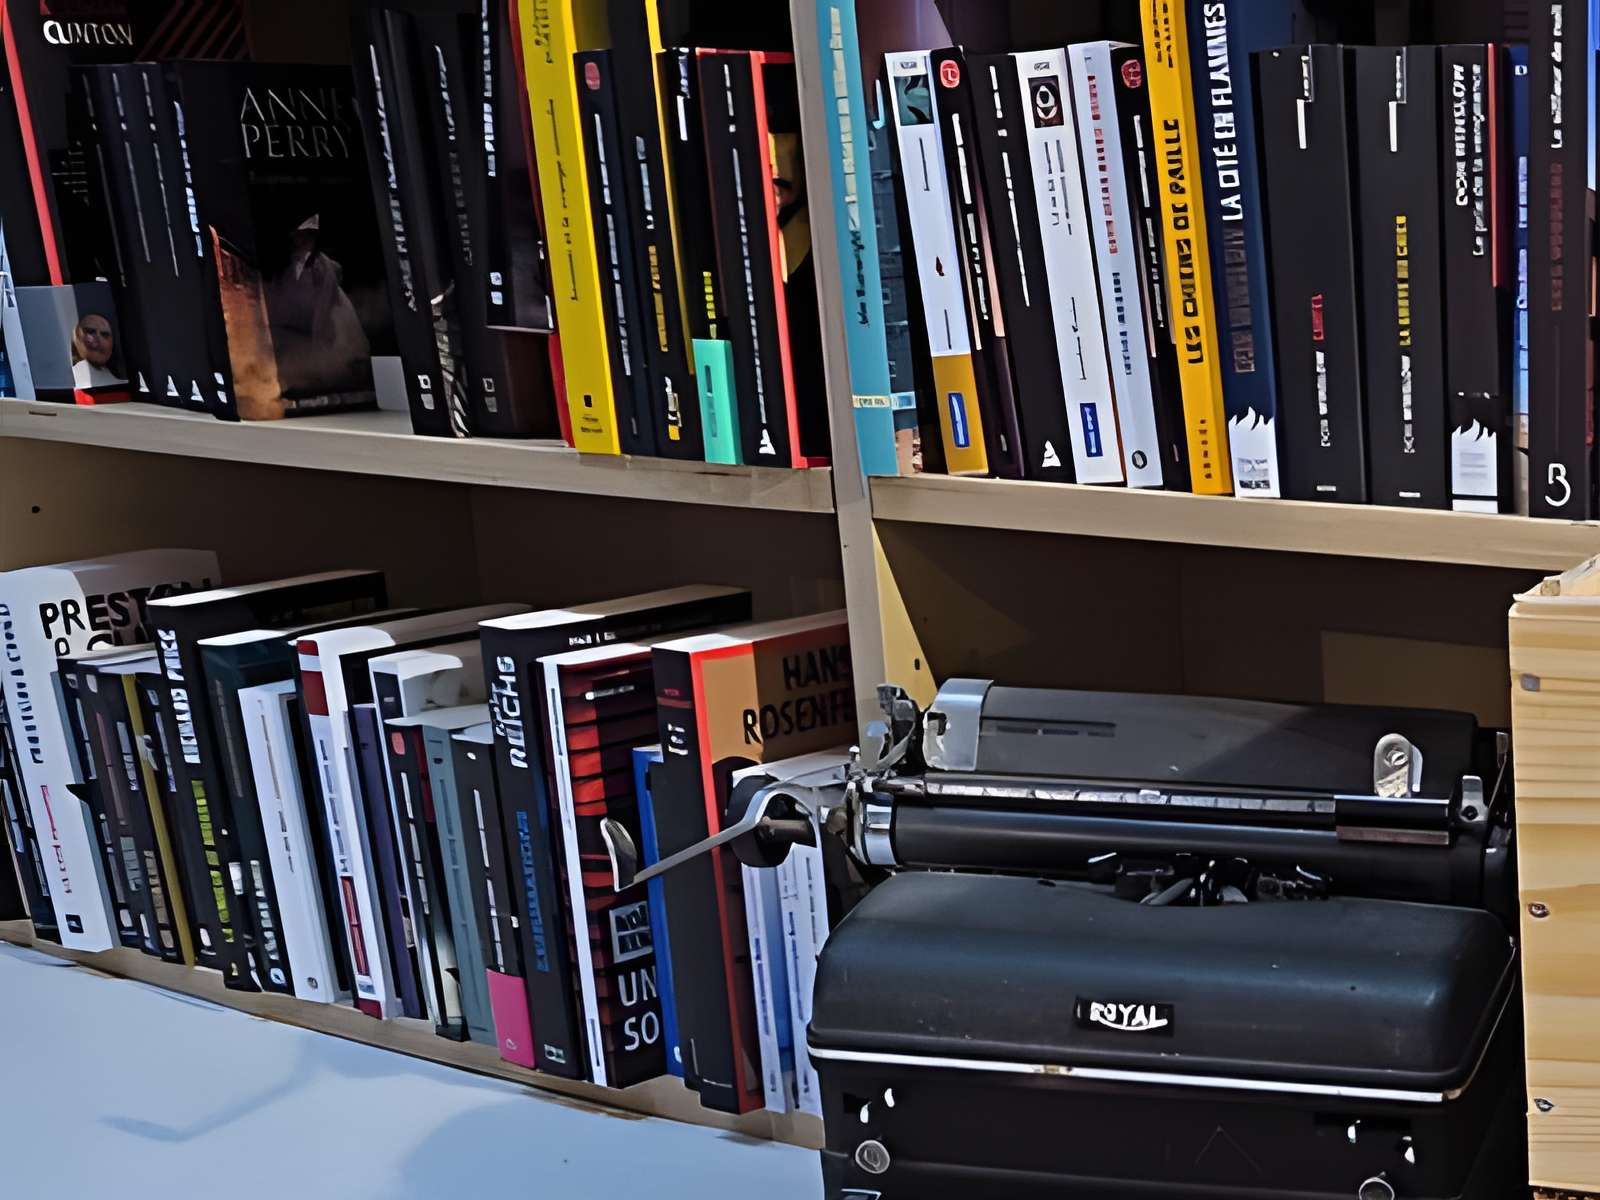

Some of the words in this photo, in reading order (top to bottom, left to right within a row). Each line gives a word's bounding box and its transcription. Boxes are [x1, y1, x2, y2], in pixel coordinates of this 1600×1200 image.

[240, 87, 352, 121] ANNE
[243, 121, 351, 159] PERRY
[1221, 194, 1243, 221] LA
[1090, 1001, 1168, 1030] ROYAL
